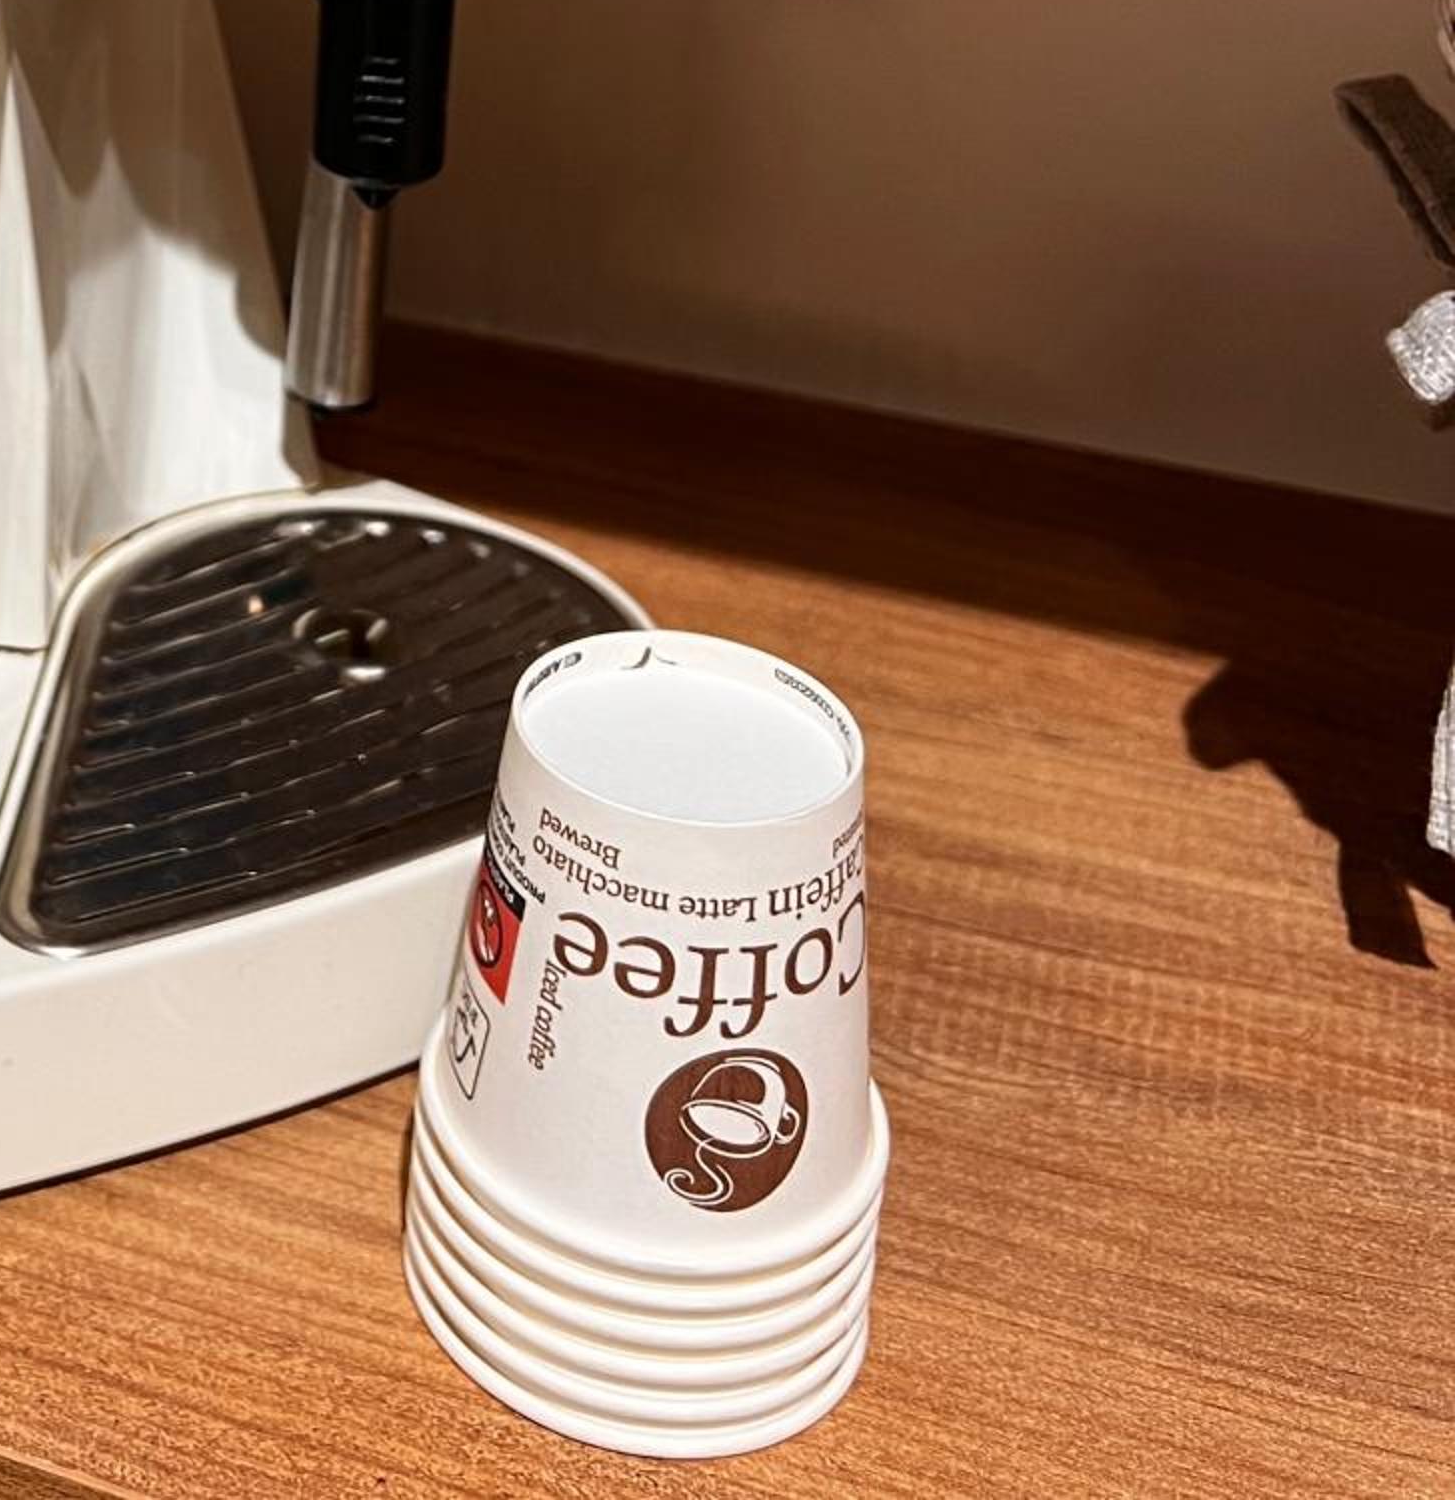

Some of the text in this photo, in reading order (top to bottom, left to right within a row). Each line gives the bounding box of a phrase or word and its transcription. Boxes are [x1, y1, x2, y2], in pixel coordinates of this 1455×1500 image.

[532, 834, 669, 912] macchiato
[539, 808, 621, 869] Brewed
[680, 895, 757, 922] Latte
[553, 890, 866, 1039] Coffee
[528, 958, 569, 1071] Iced coffee
